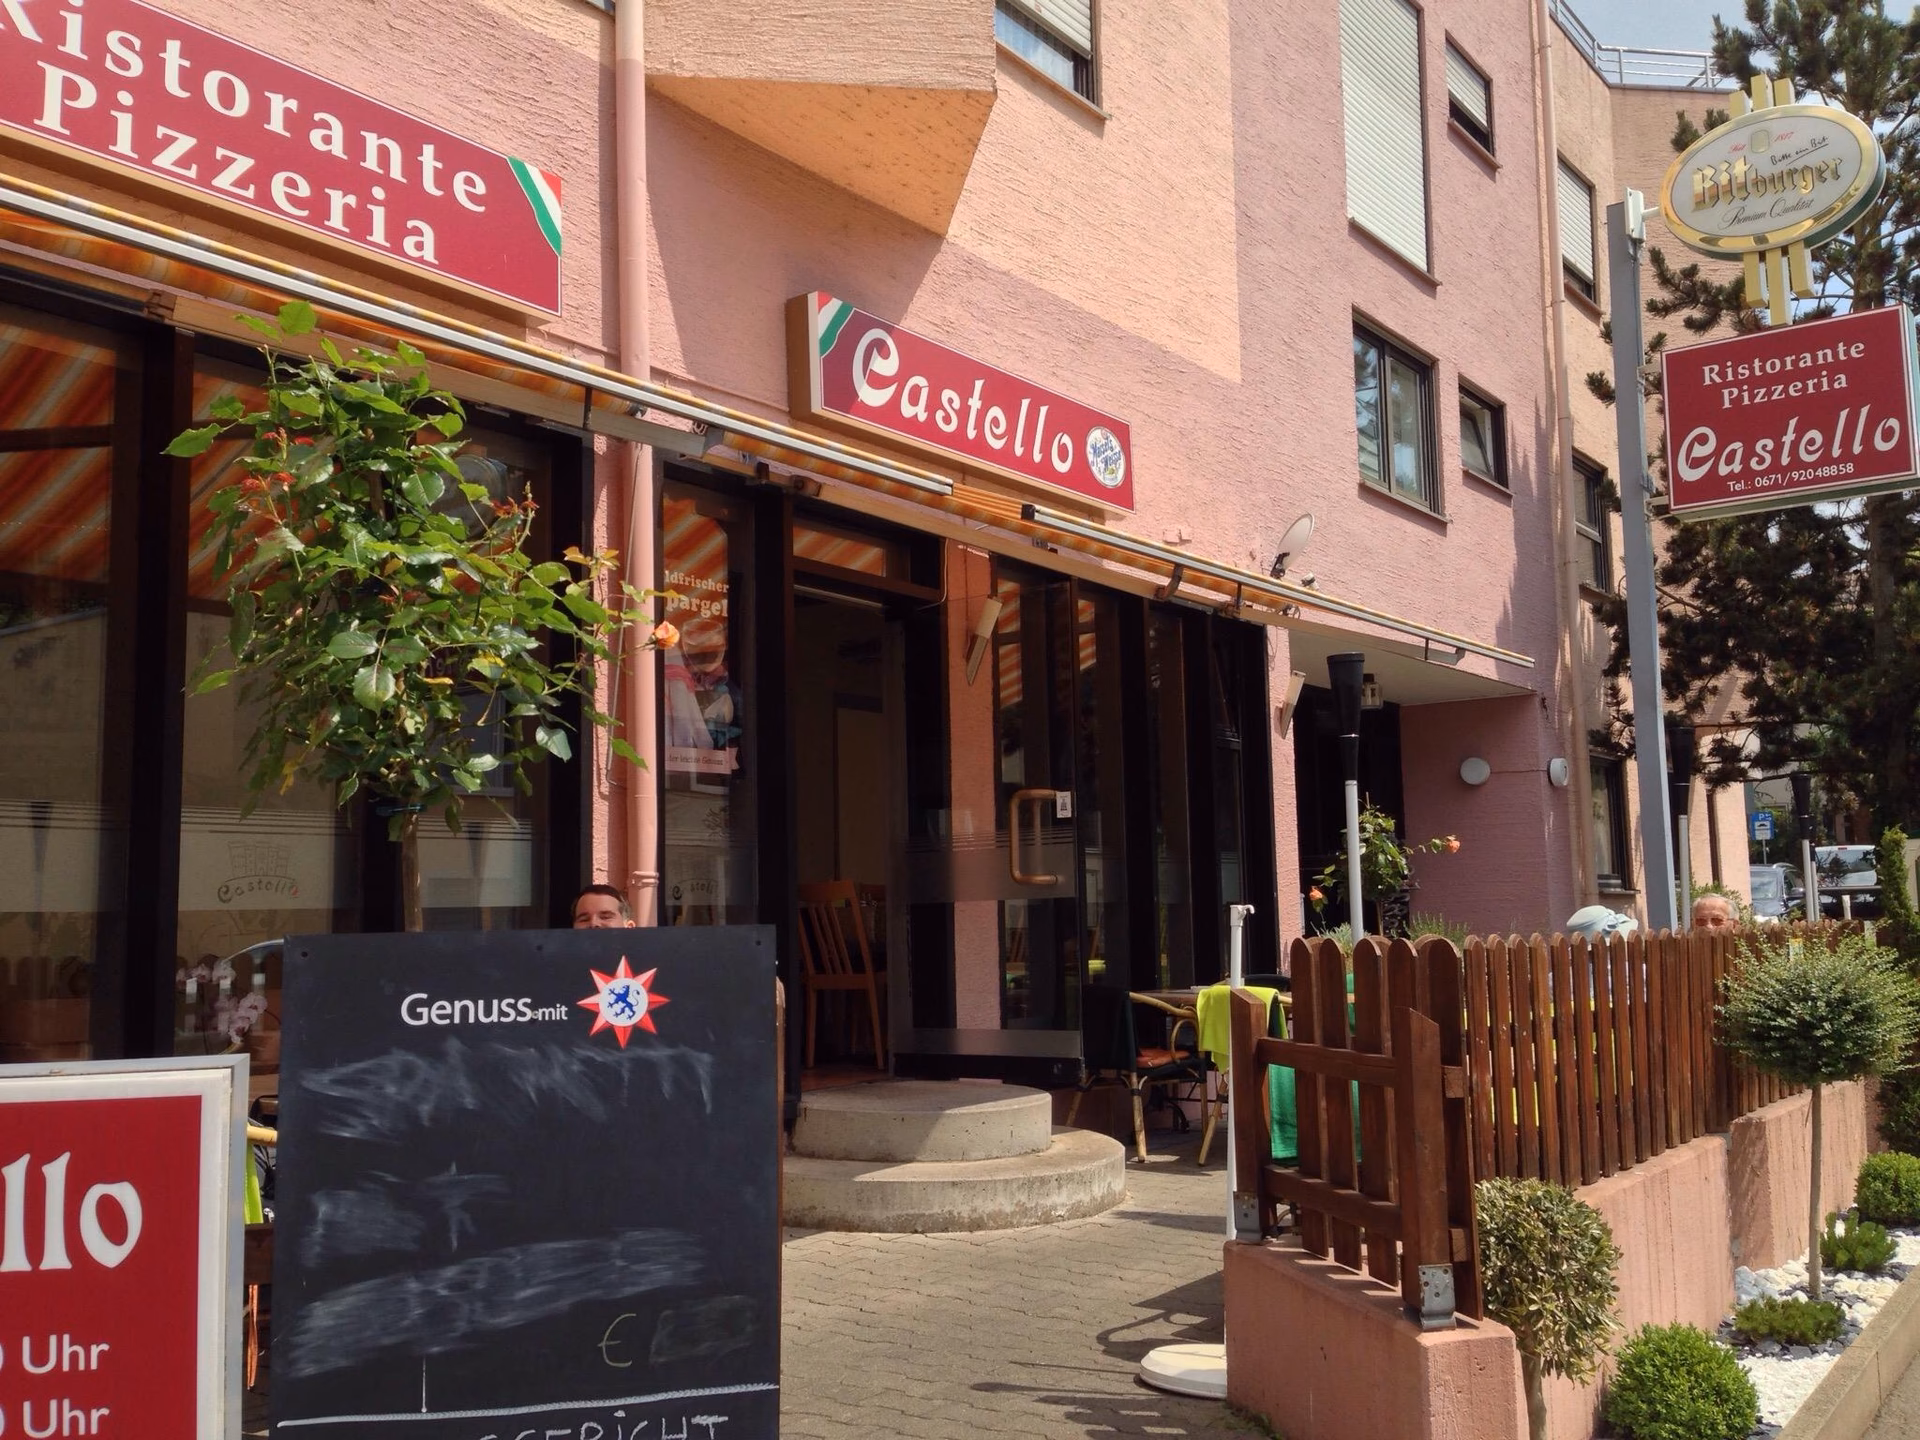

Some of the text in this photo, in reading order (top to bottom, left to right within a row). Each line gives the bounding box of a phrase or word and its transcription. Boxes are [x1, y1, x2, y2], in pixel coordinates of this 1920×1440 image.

[33, 60, 439, 265] Pizzeria
[1691, 156, 1843, 212] Bitburger
[1717, 197, 1815, 230] Premium Qualität
[1702, 341, 1865, 386] Ristorante
[852, 328, 1074, 473] Castello
[1721, 370, 1848, 409] Pizzeria
[1677, 404, 1900, 483] Castello
[1755, 463, 1854, 489] 0671/92048858
[400, 993, 568, 1026] Genuss mit
[0, 1151, 143, 1272] llo
[22, 1334, 110, 1374] Uhr
[23, 1399, 110, 1439] Uhr
